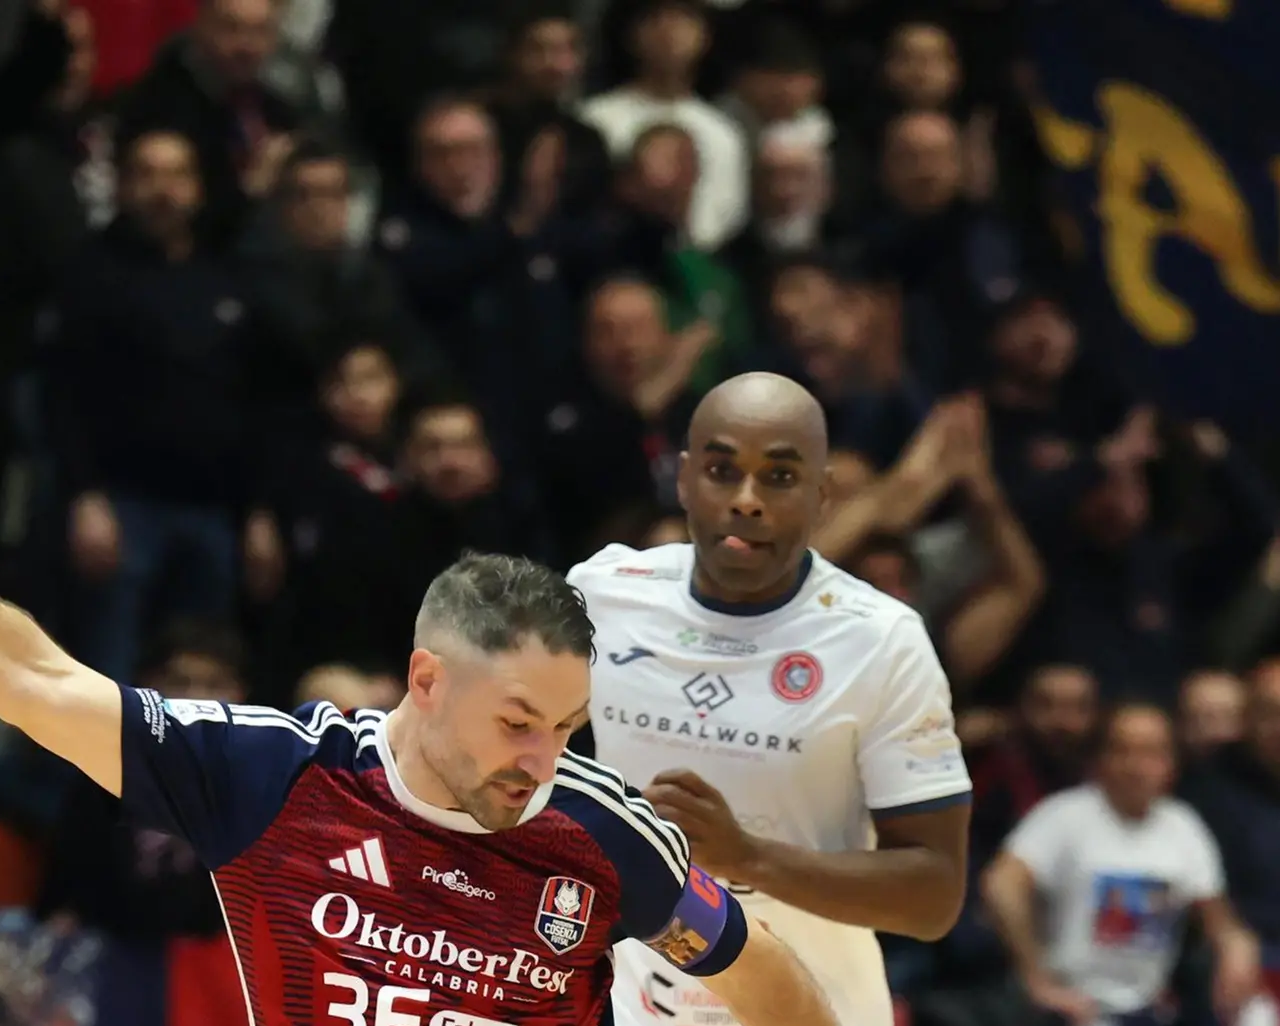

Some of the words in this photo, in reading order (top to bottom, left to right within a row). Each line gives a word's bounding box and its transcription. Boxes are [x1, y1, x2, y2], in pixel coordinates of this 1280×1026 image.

[604, 706, 804, 754] GLOBALWORK
[311, 892, 574, 995] OktoberFest
[384, 960, 505, 1001] CALABRIA
